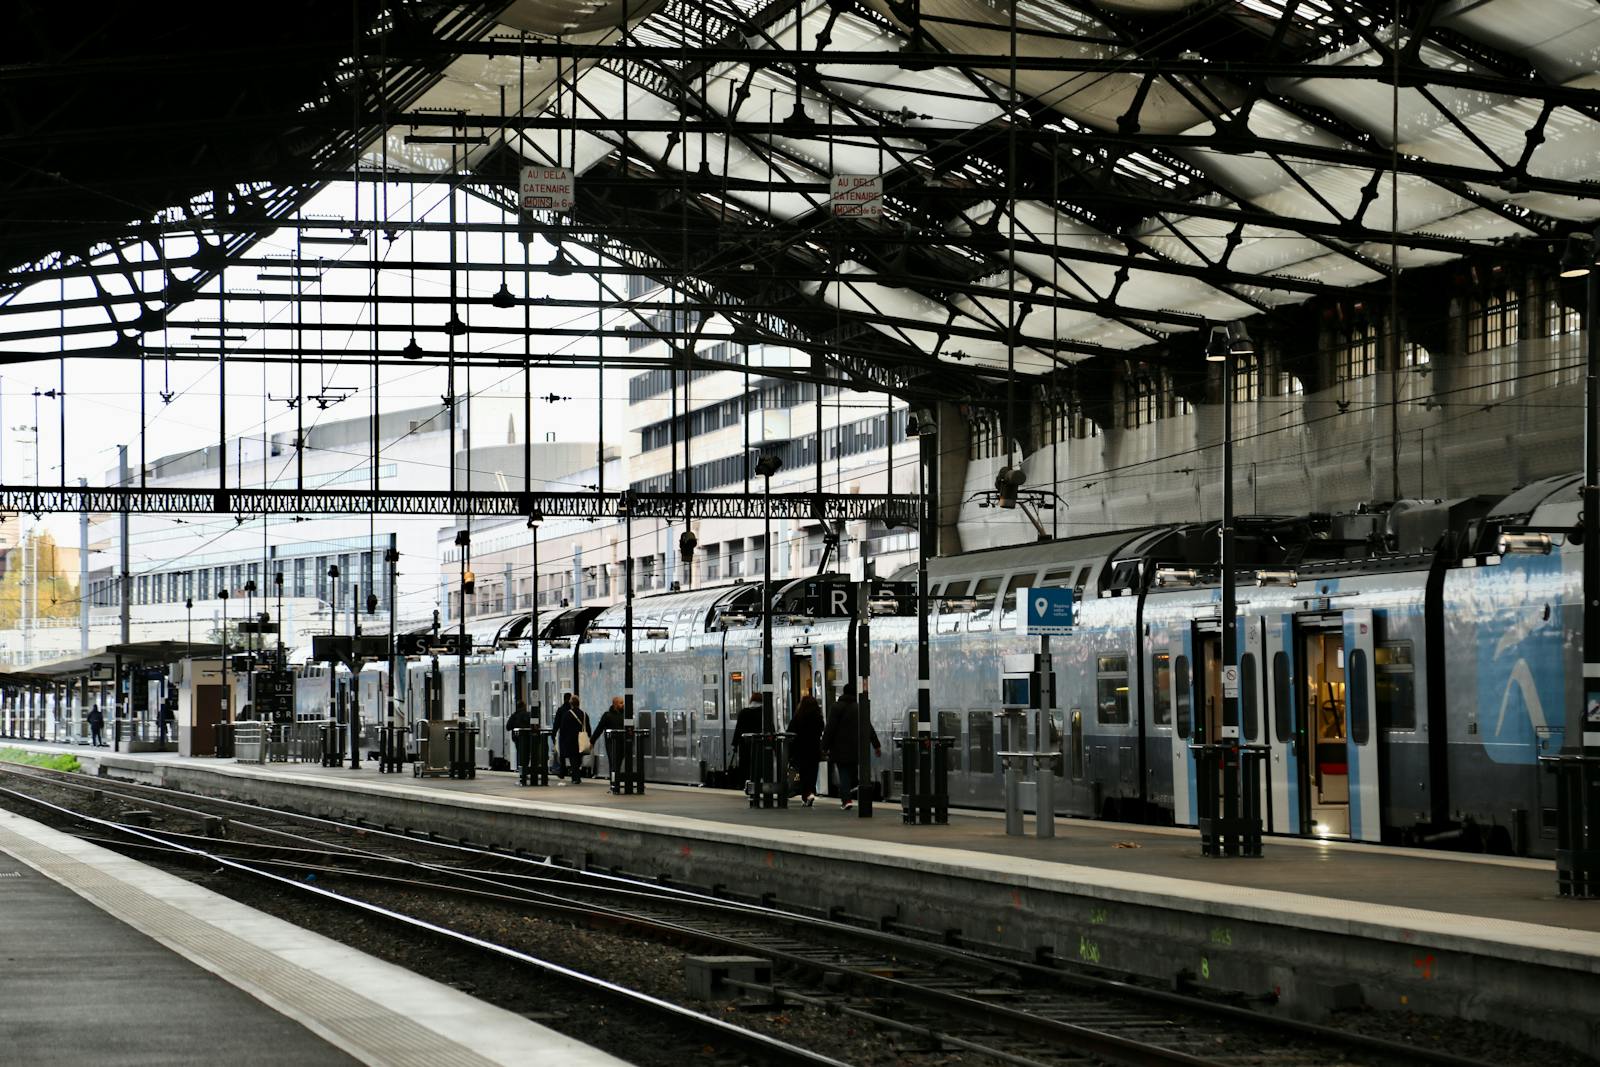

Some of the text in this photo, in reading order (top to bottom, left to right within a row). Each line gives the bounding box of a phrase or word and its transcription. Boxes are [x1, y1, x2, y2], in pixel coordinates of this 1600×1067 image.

[527, 170, 566, 180] AU DELA
[838, 178, 875, 187] AU DELA
[523, 183, 571, 194] CATENAIRE
[833, 191, 880, 201] CATENAIRE
[526, 198, 551, 207] MOINS
[836, 205, 861, 214] MOINS
[831, 590, 849, 615] R
[415, 639, 426, 655] S
[243, 659, 253, 671] T
